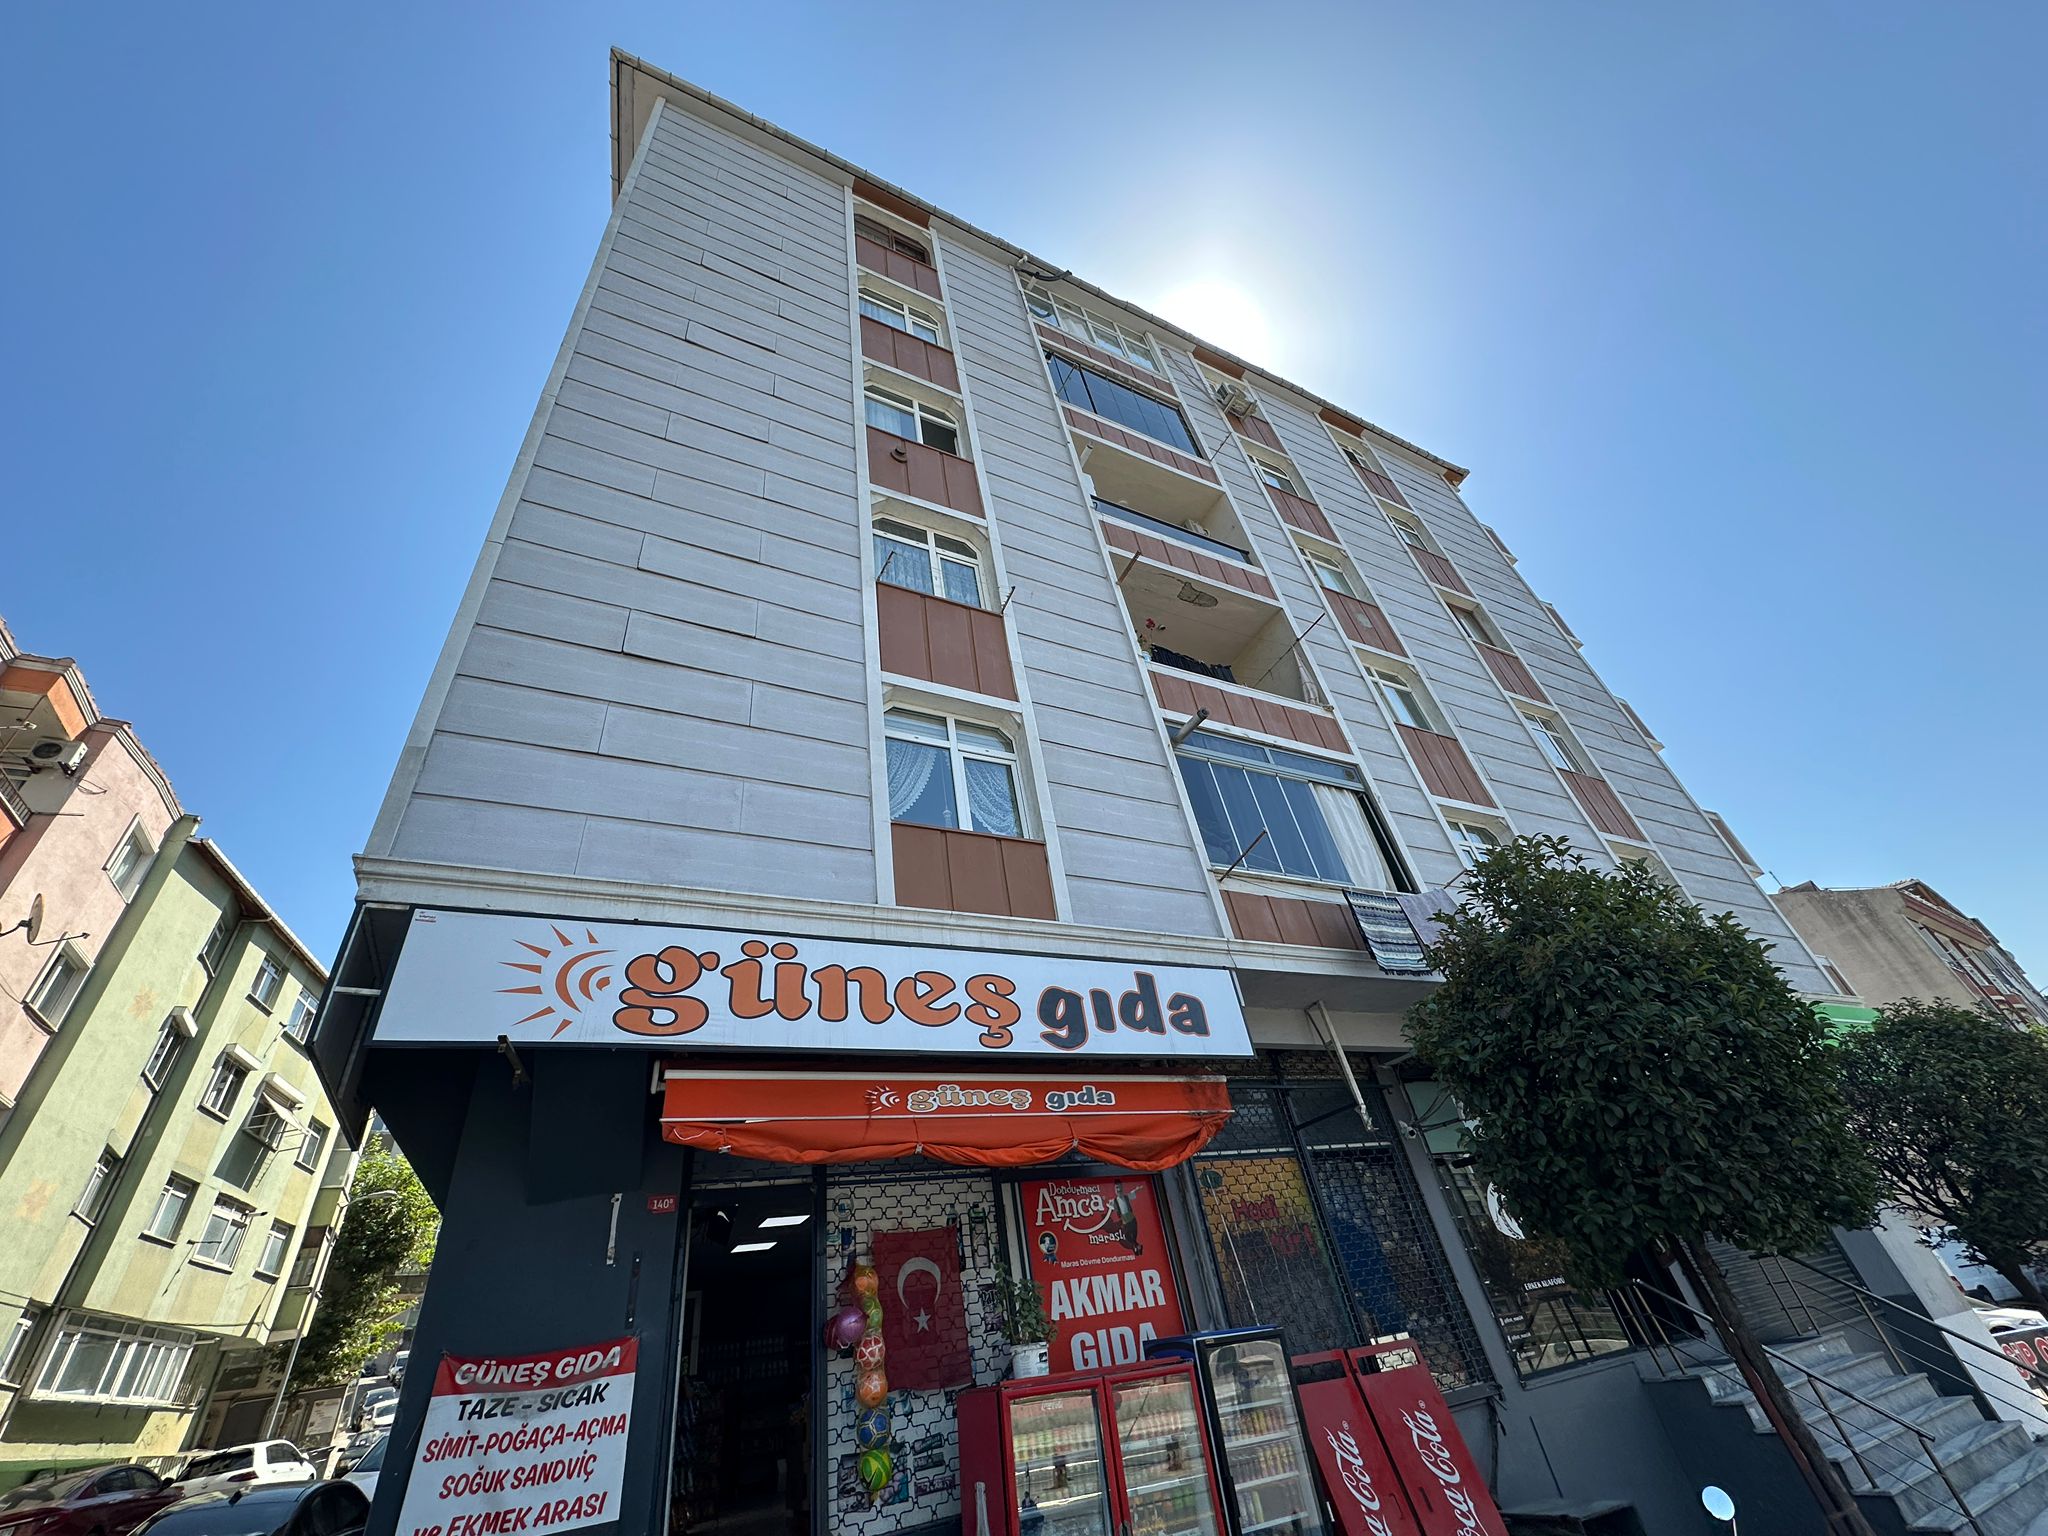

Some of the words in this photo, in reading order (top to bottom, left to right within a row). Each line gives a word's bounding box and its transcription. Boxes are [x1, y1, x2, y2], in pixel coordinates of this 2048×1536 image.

[612, 940, 1021, 1048] güneş
[1036, 970, 1210, 1051] gıda
[907, 1084, 1032, 1112] güneş
[1045, 1085, 1115, 1111] gıda
[1036, 1188, 1105, 1226] Amca
[1051, 1269, 1166, 1321] AKMAR
[455, 1360, 550, 1387] GÜNEŞ
[555, 1346, 621, 1379] GIDA
[1070, 1322, 1158, 1371] GIDA
[458, 1398, 515, 1421] TAZE
[537, 1382, 610, 1413] SICAK
[439, 1465, 510, 1499] SOĞUK
[511, 1449, 597, 1490] SANDVİÇ
[446, 1506, 533, 1536] EKMEK
[532, 1491, 608, 1527] ARASI
